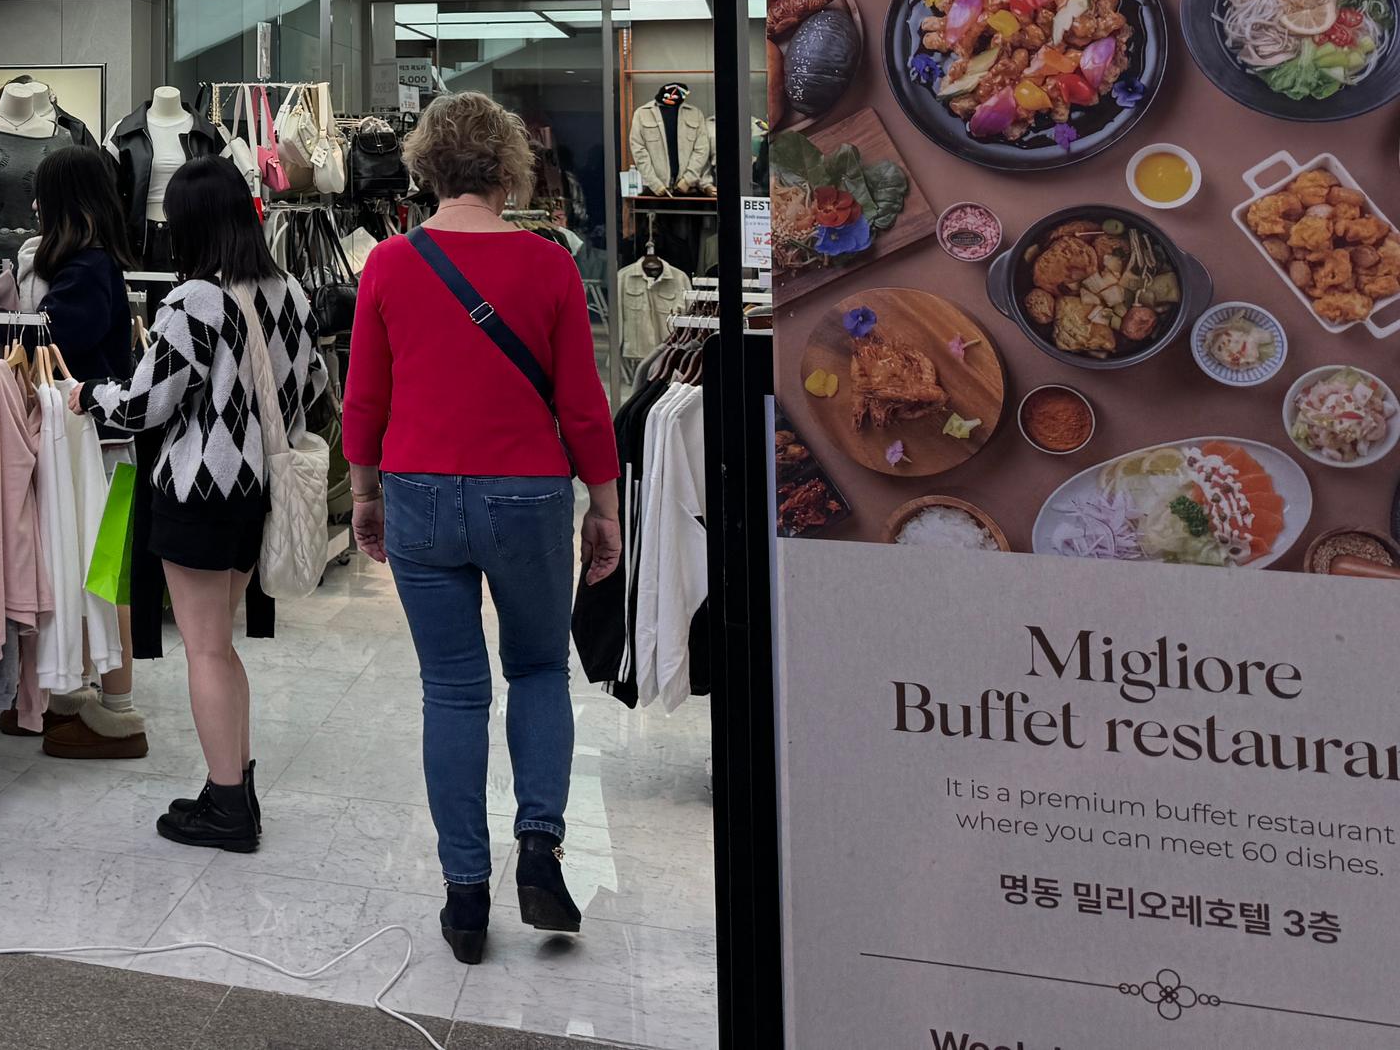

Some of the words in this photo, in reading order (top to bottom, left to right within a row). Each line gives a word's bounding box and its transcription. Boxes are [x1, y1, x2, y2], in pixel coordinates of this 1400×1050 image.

[743, 200, 771, 211] BEST
[1024, 625, 1303, 704] Migliore
[891, 680, 1086, 750] Buffet
[945, 777, 963, 798] It
[970, 779, 990, 800] is
[996, 786, 1011, 802] a
[1019, 788, 1146, 817] premium
[1155, 798, 1239, 828] buffet
[1247, 813, 1396, 846] restaurant
[955, 810, 1039, 837] where
[1044, 822, 1094, 844] you
[1102, 829, 1151, 850] can
[1160, 835, 1235, 860] meet
[1241, 841, 1277, 864] 60
[1285, 846, 1384, 877] dishes.
[1000, 873, 1062, 910] 명동
[1073, 882, 1271, 937] 밀리오레호텔
[1283, 909, 1342, 945] 3층
